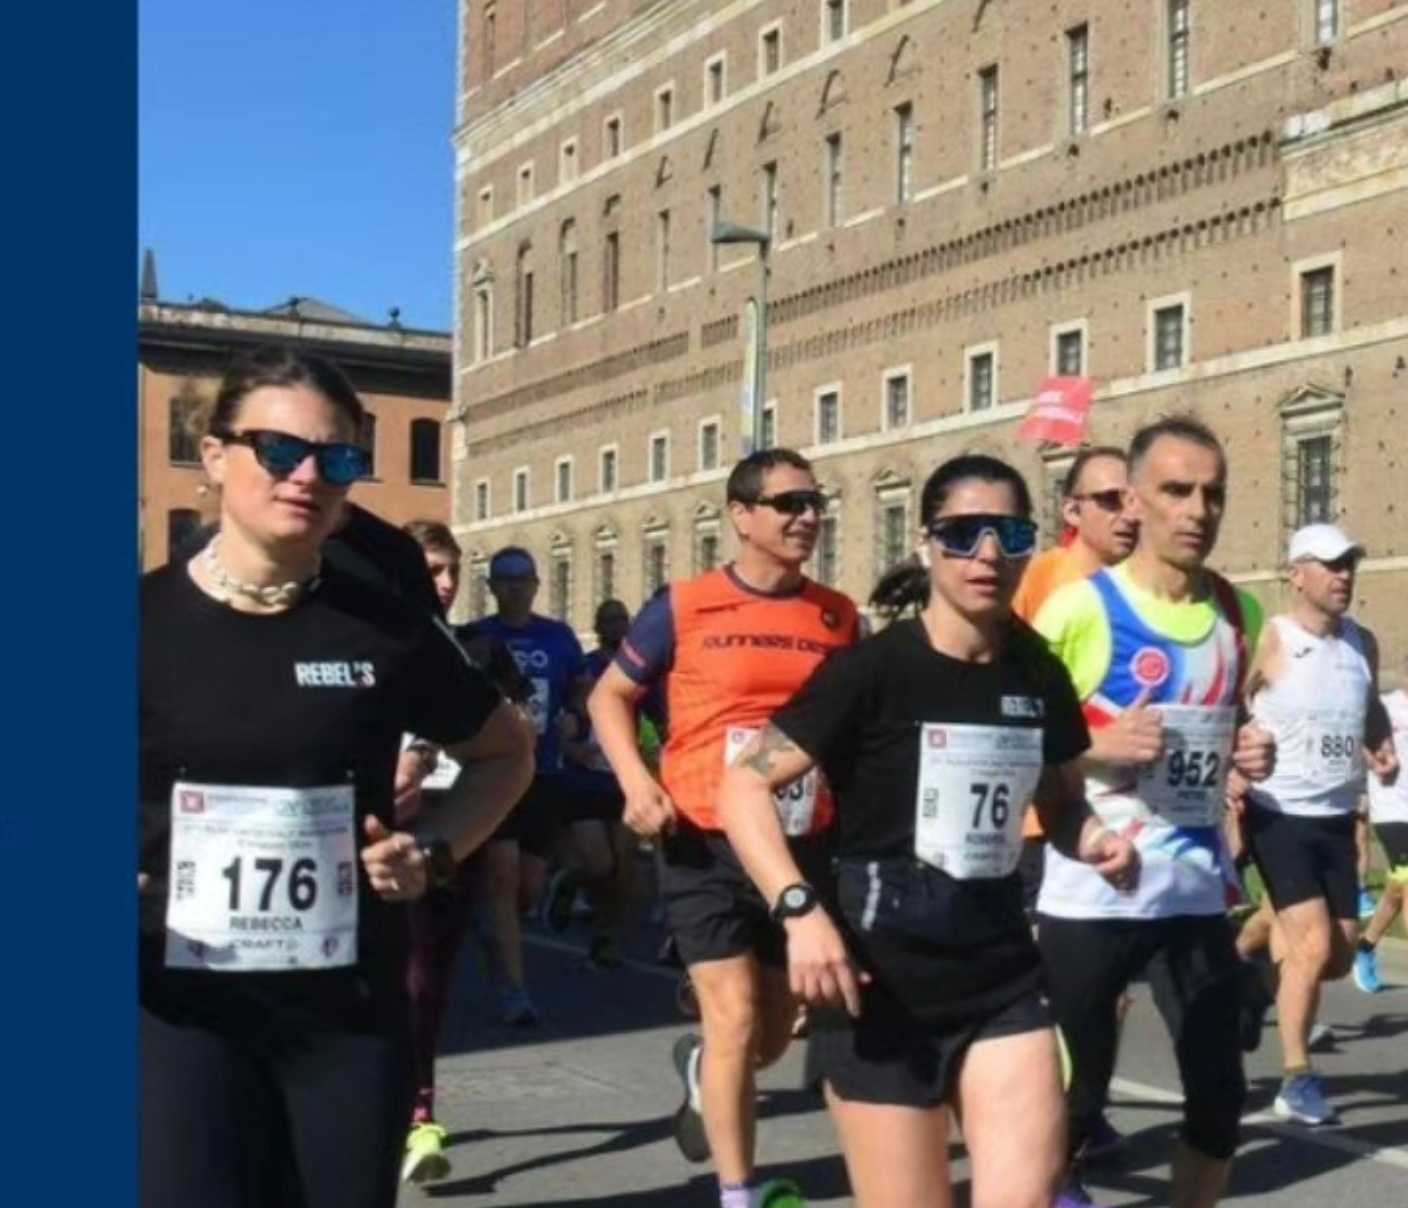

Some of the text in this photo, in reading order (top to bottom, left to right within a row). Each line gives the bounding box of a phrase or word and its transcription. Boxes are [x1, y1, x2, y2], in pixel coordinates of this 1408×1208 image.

[294, 661, 376, 687] REBEL'S
[1321, 735, 1354, 758] 880
[1167, 750, 1220, 787] 952
[970, 783, 1009, 829] 76
[222, 857, 317, 911] 176
[229, 916, 303, 930] REBECCA
